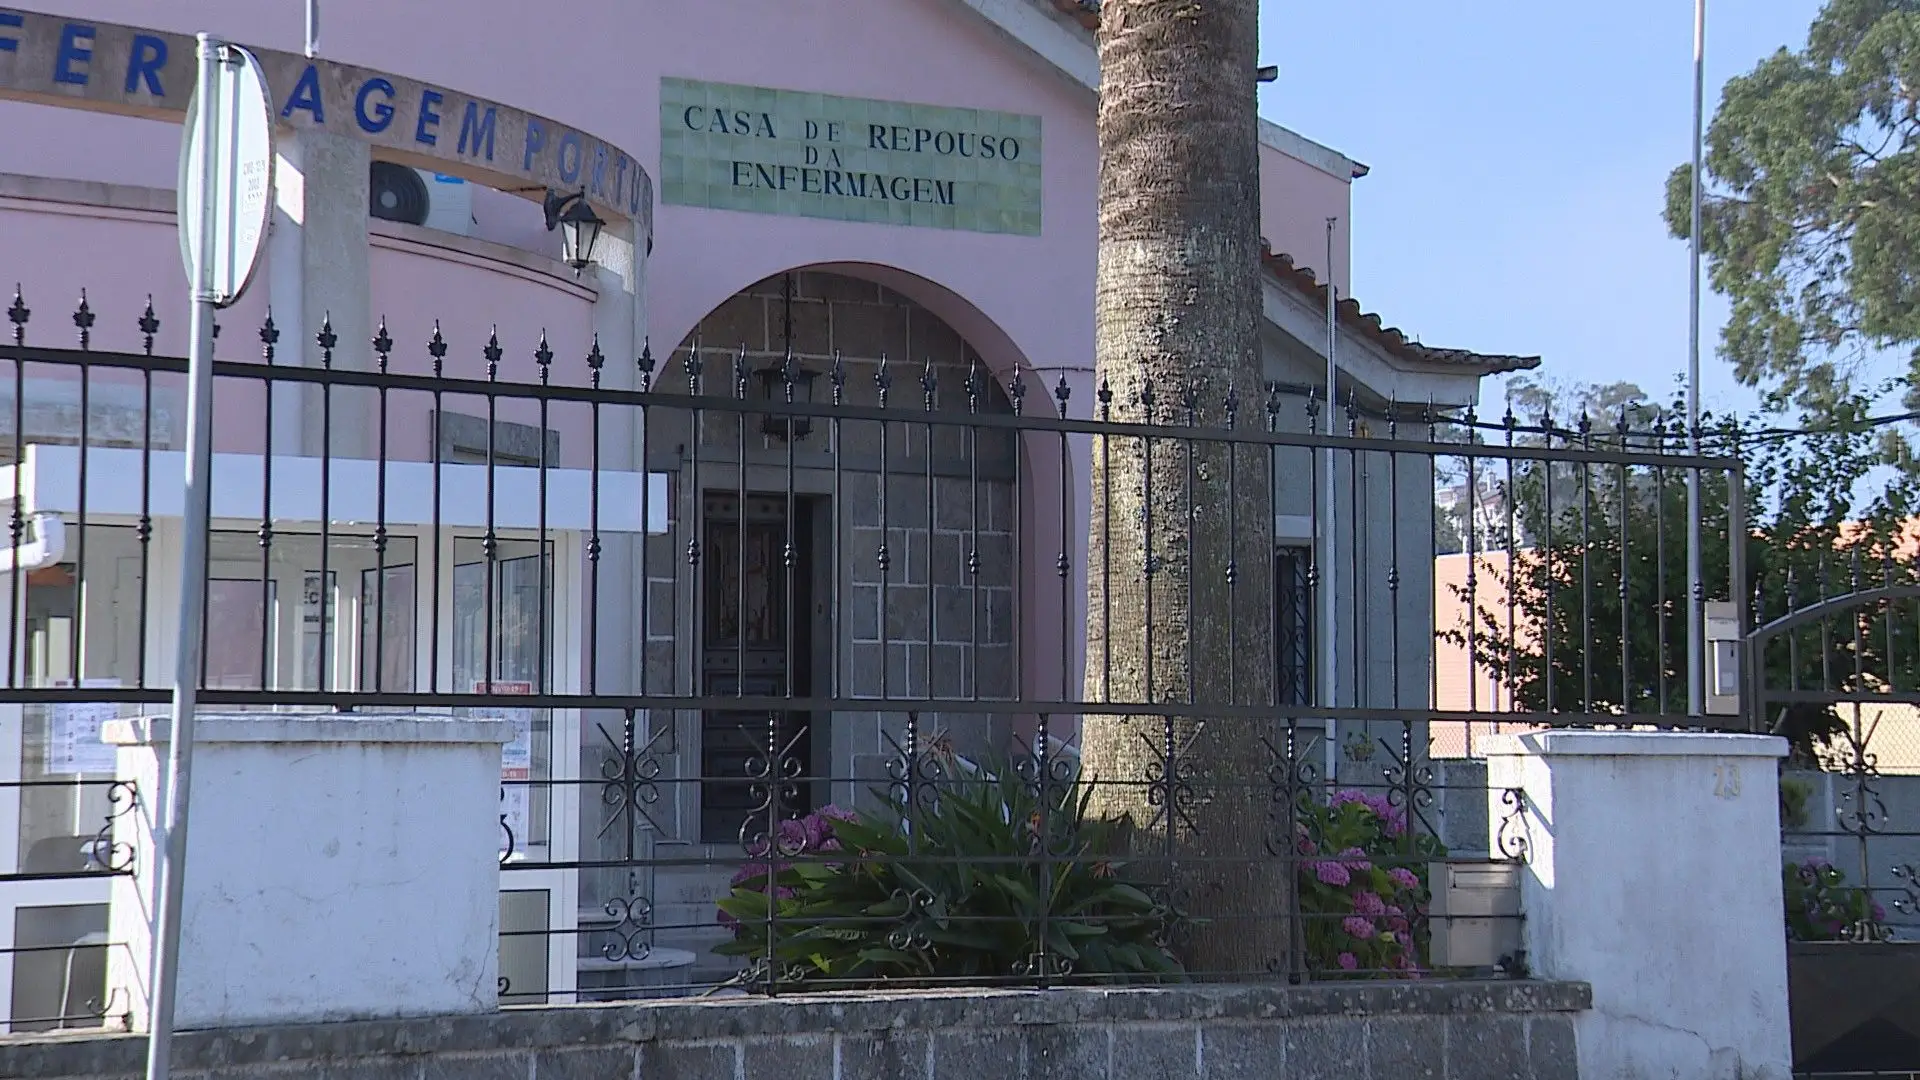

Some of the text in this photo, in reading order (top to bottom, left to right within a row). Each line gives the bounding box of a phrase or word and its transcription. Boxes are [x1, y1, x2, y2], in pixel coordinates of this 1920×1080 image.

[0, 13, 496, 161] FERAGEM
[684, 105, 1020, 162] CASA DE REPOUSO
[805, 145, 841, 168] DA
[732, 160, 955, 205] ENFERMAGEM
